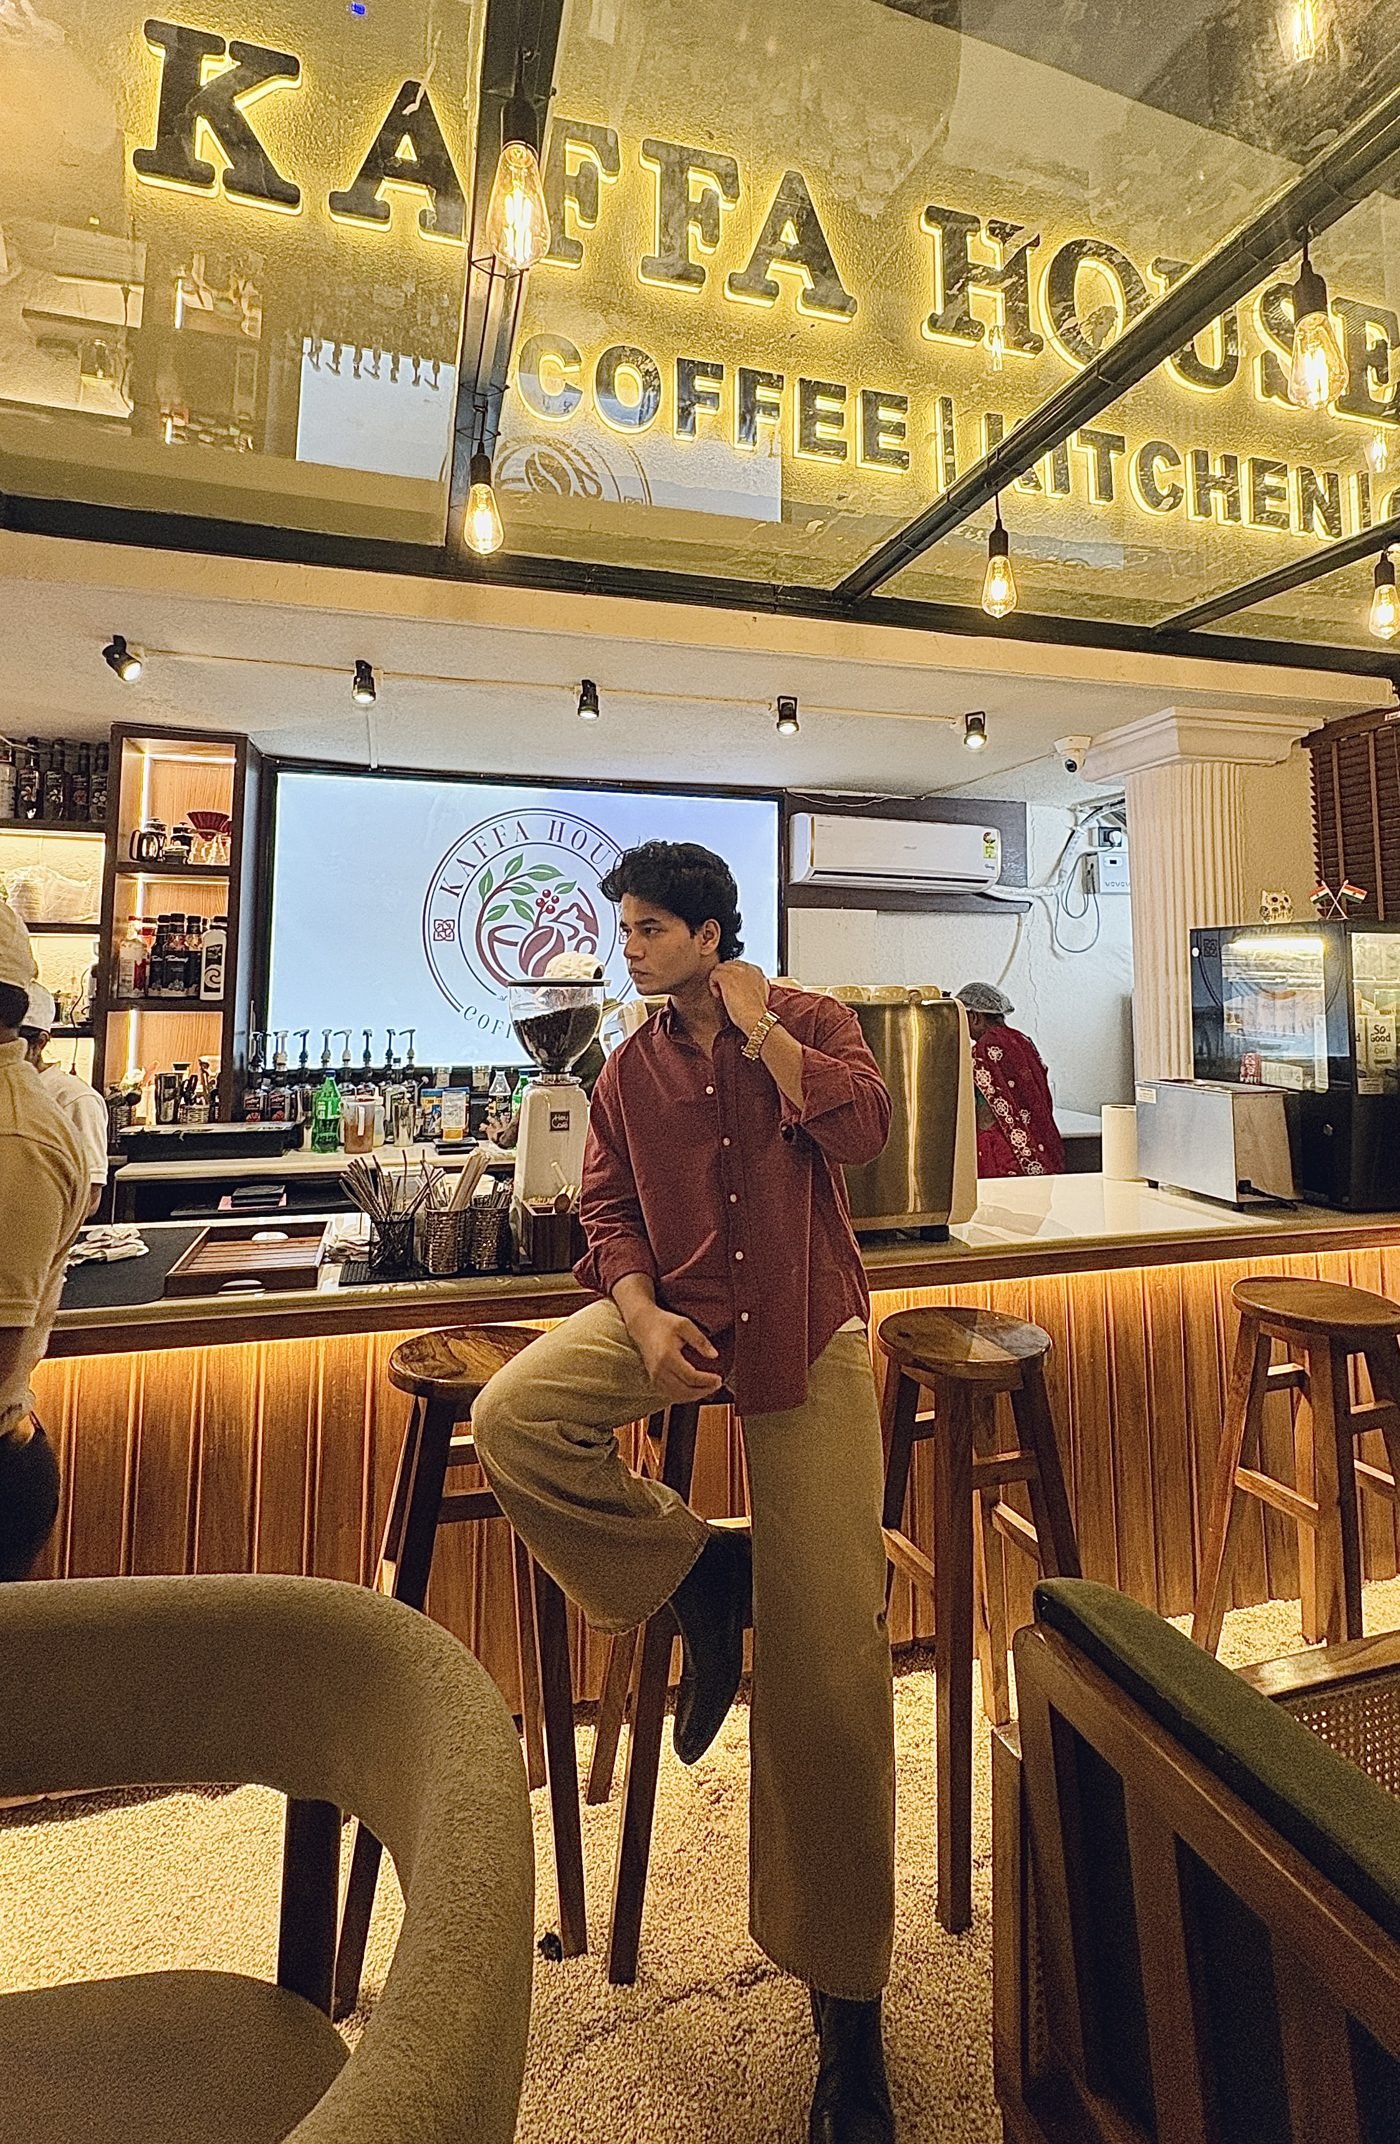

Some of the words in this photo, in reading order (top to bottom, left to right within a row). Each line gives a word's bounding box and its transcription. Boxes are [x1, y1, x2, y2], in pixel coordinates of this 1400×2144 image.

[132, 18, 858, 323] KAFFA
[517, 333, 910, 474] COFFEE
[439, 819, 530, 898] KAFFA
[547, 819, 612, 878] HOU
[1370, 1032, 1391, 1043] Good
